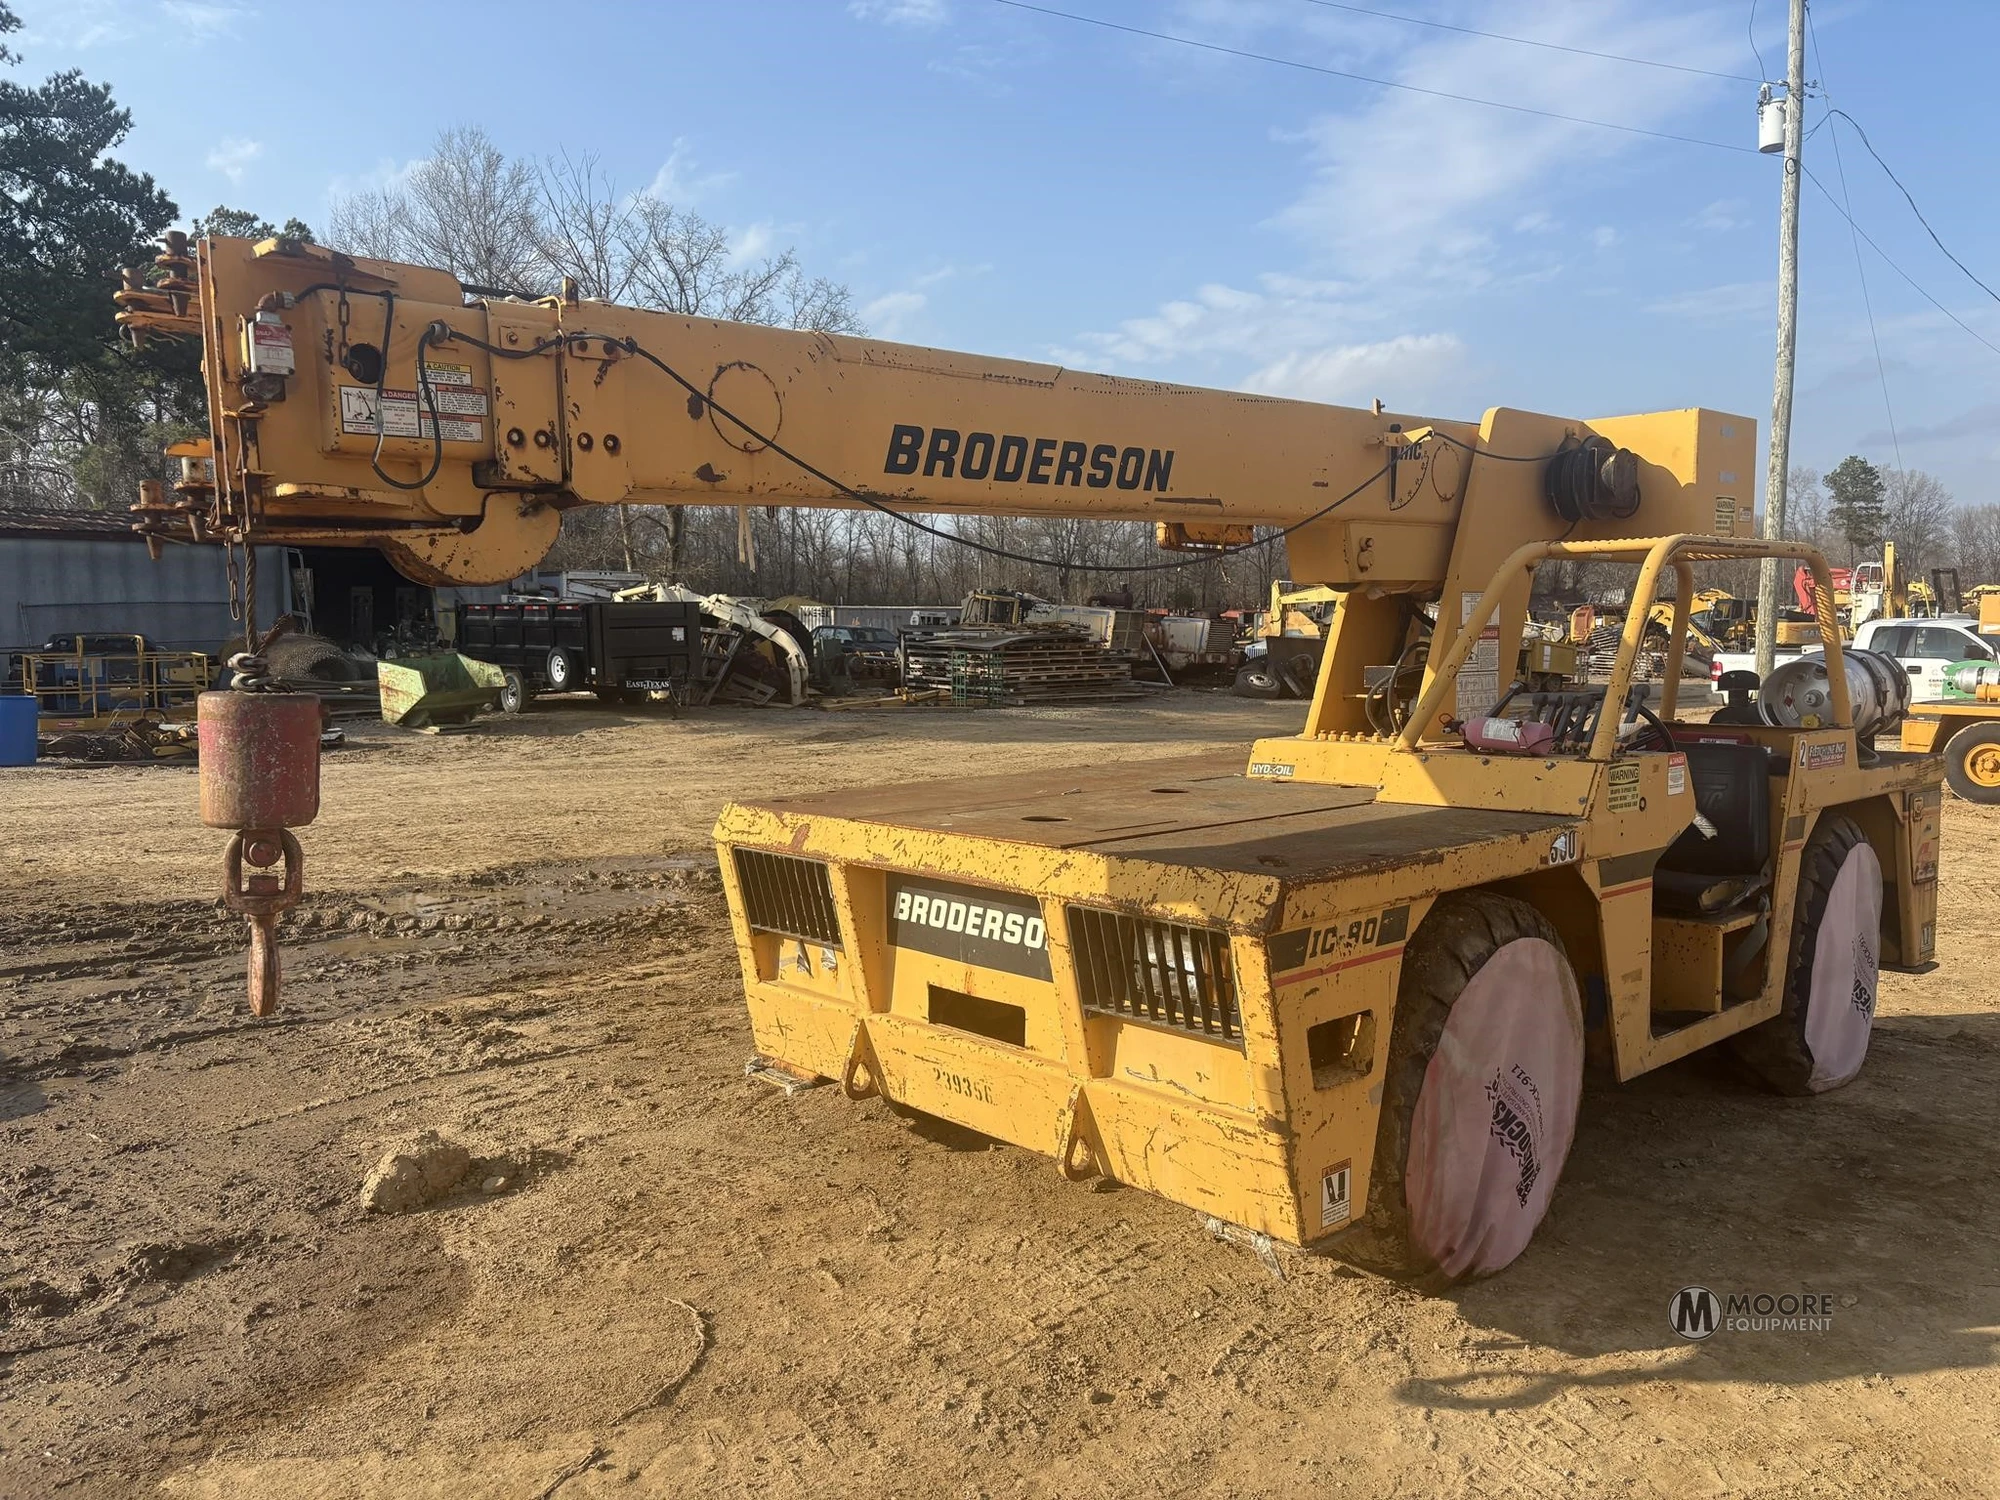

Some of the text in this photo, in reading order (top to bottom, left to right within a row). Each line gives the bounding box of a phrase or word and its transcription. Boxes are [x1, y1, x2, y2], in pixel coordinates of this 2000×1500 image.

[433, 363, 460, 371] CAUTION
[388, 391, 417, 399] DANGER
[884, 424, 1174, 491] BRODERSON
[626, 680, 644, 688] EAST
[644, 680, 669, 689] TEXAS
[1800, 741, 1807, 767] 2
[1276, 765, 1293, 777] OIL
[1609, 768, 1639, 782] WARNING
[893, 892, 1049, 951] BRODERSO
